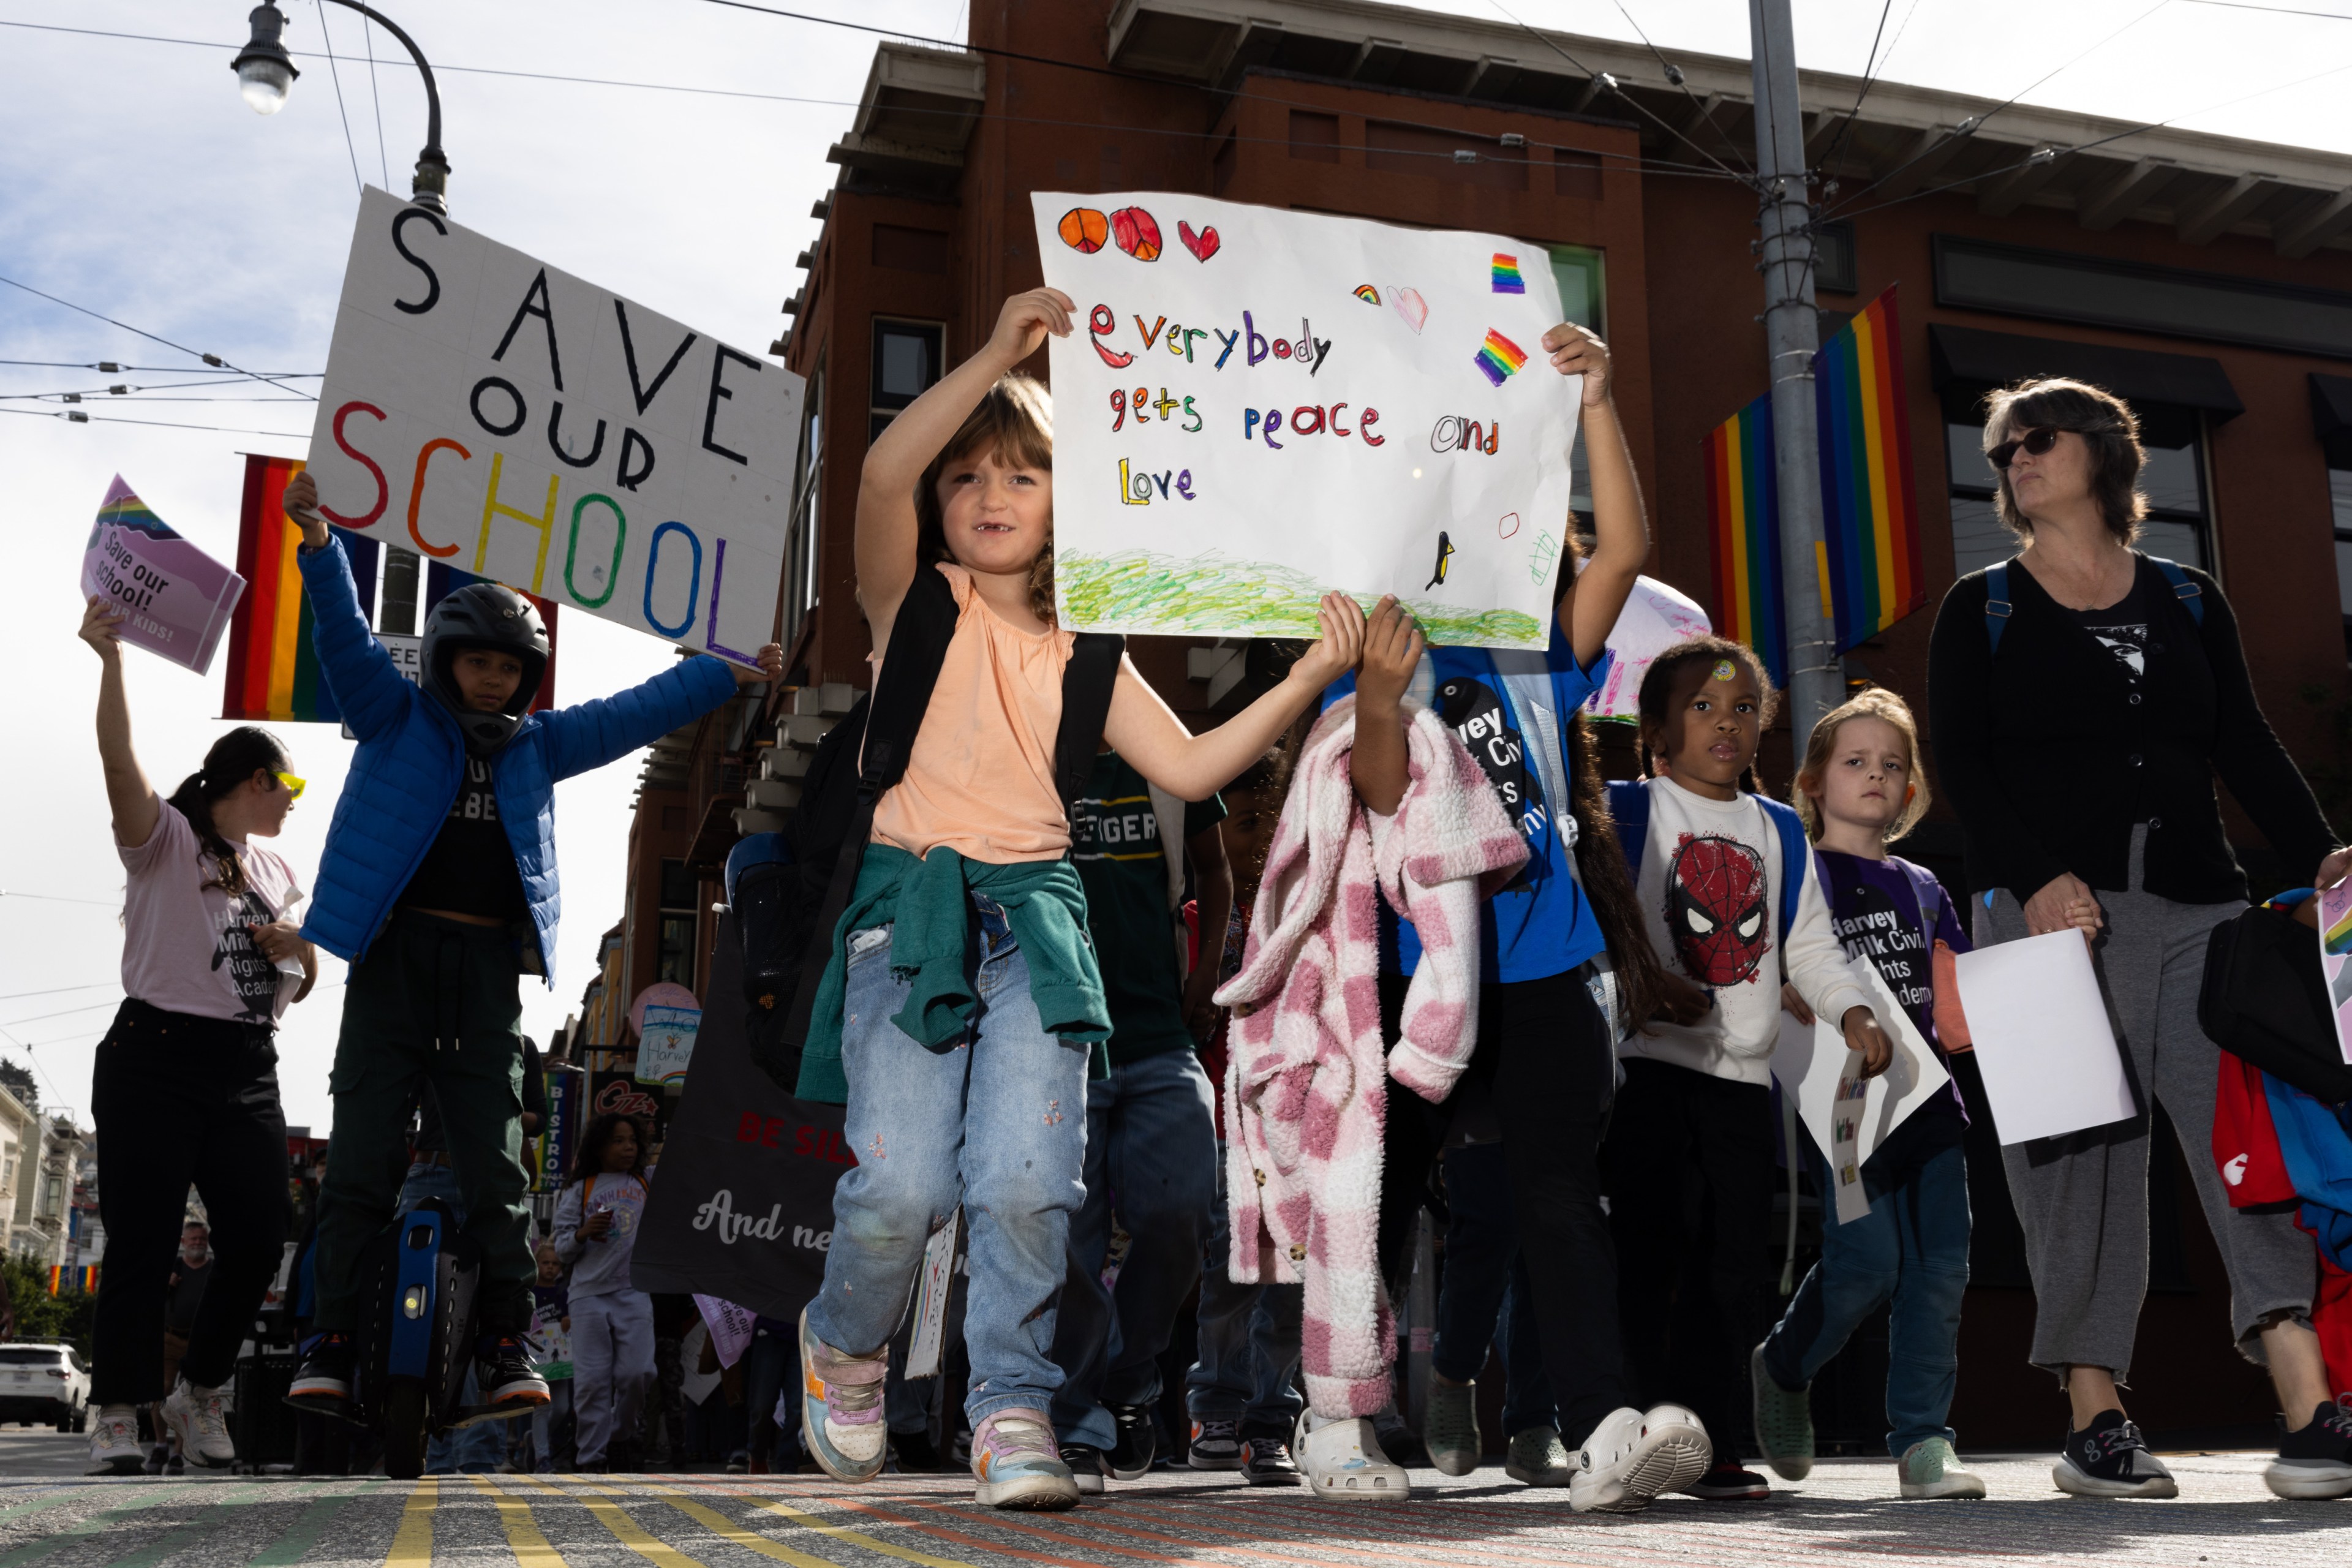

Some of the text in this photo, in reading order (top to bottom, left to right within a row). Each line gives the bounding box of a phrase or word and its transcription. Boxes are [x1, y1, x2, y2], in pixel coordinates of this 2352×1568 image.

[391, 208, 762, 467] SAVE
[1089, 304, 1332, 377] everybody
[470, 375, 655, 492] OUR
[1109, 387, 1499, 456] gets peace and
[1118, 458, 1197, 506] Love
[317, 400, 759, 668] SCHOOL
[105, 530, 133, 570] Save
[132, 564, 169, 595] our
[96, 560, 153, 612] school!
[132, 612, 175, 643] KIDS!
[1455, 707, 1502, 744] vey
[1487, 735, 1521, 766] Civ
[217, 932, 252, 952] Milk
[1831, 910, 1898, 938] Harvey
[1838, 927, 1925, 965] Milk Civi
[224, 956, 268, 978] Rights
[1877, 959, 1911, 981] hts
[1892, 982, 1932, 1008] demy
[647, 1040, 691, 1064] Harvey
[545, 1085, 564, 1170] BISTRO
[737, 1110, 785, 1150] BE
[692, 1189, 834, 1252] And ne
[718, 1299, 741, 1337] school!
[739, 1317, 751, 1334] our
